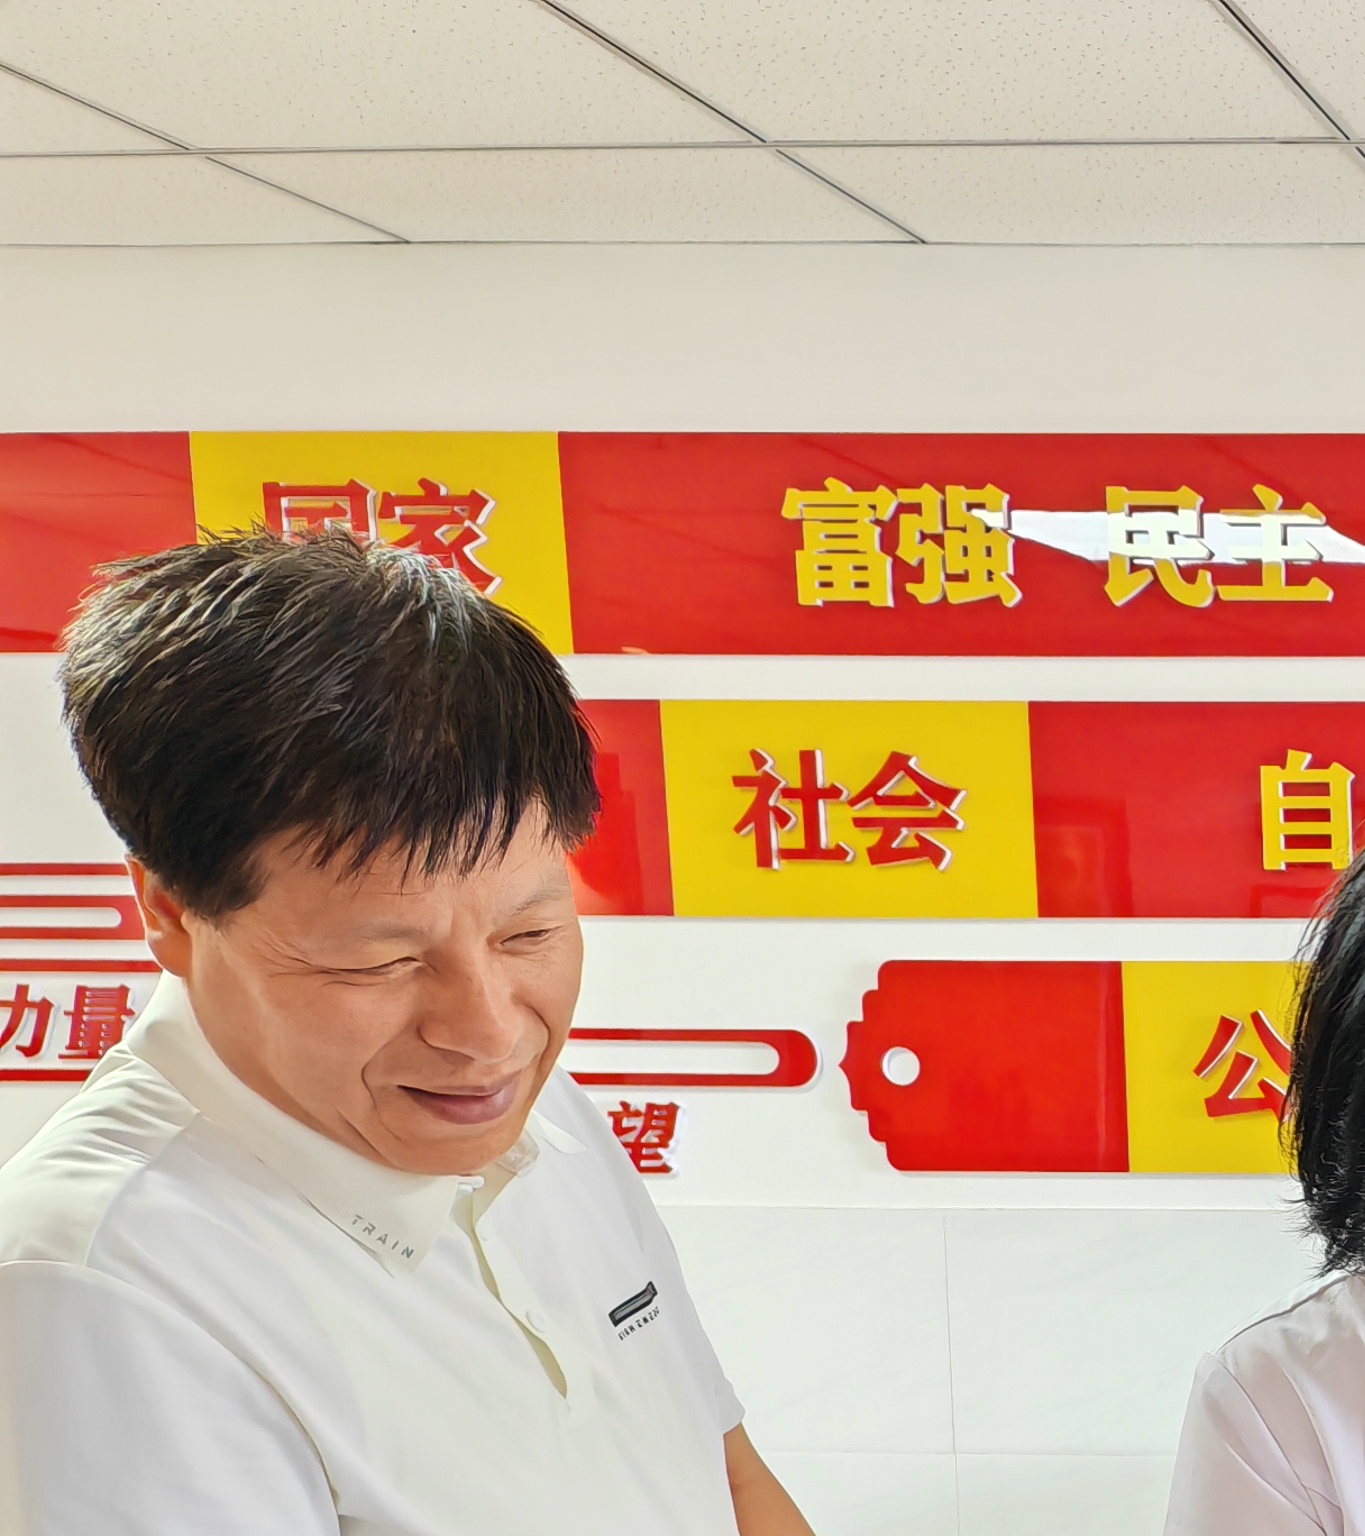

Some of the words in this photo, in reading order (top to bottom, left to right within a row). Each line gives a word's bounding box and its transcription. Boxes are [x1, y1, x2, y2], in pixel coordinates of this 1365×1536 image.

[782, 479, 1022, 608] 富强
[1105, 485, 1332, 608] 民主
[732, 748, 966, 871] 社会
[0, 984, 136, 1059] 力量
[351, 1214, 415, 1260] TRAIN
